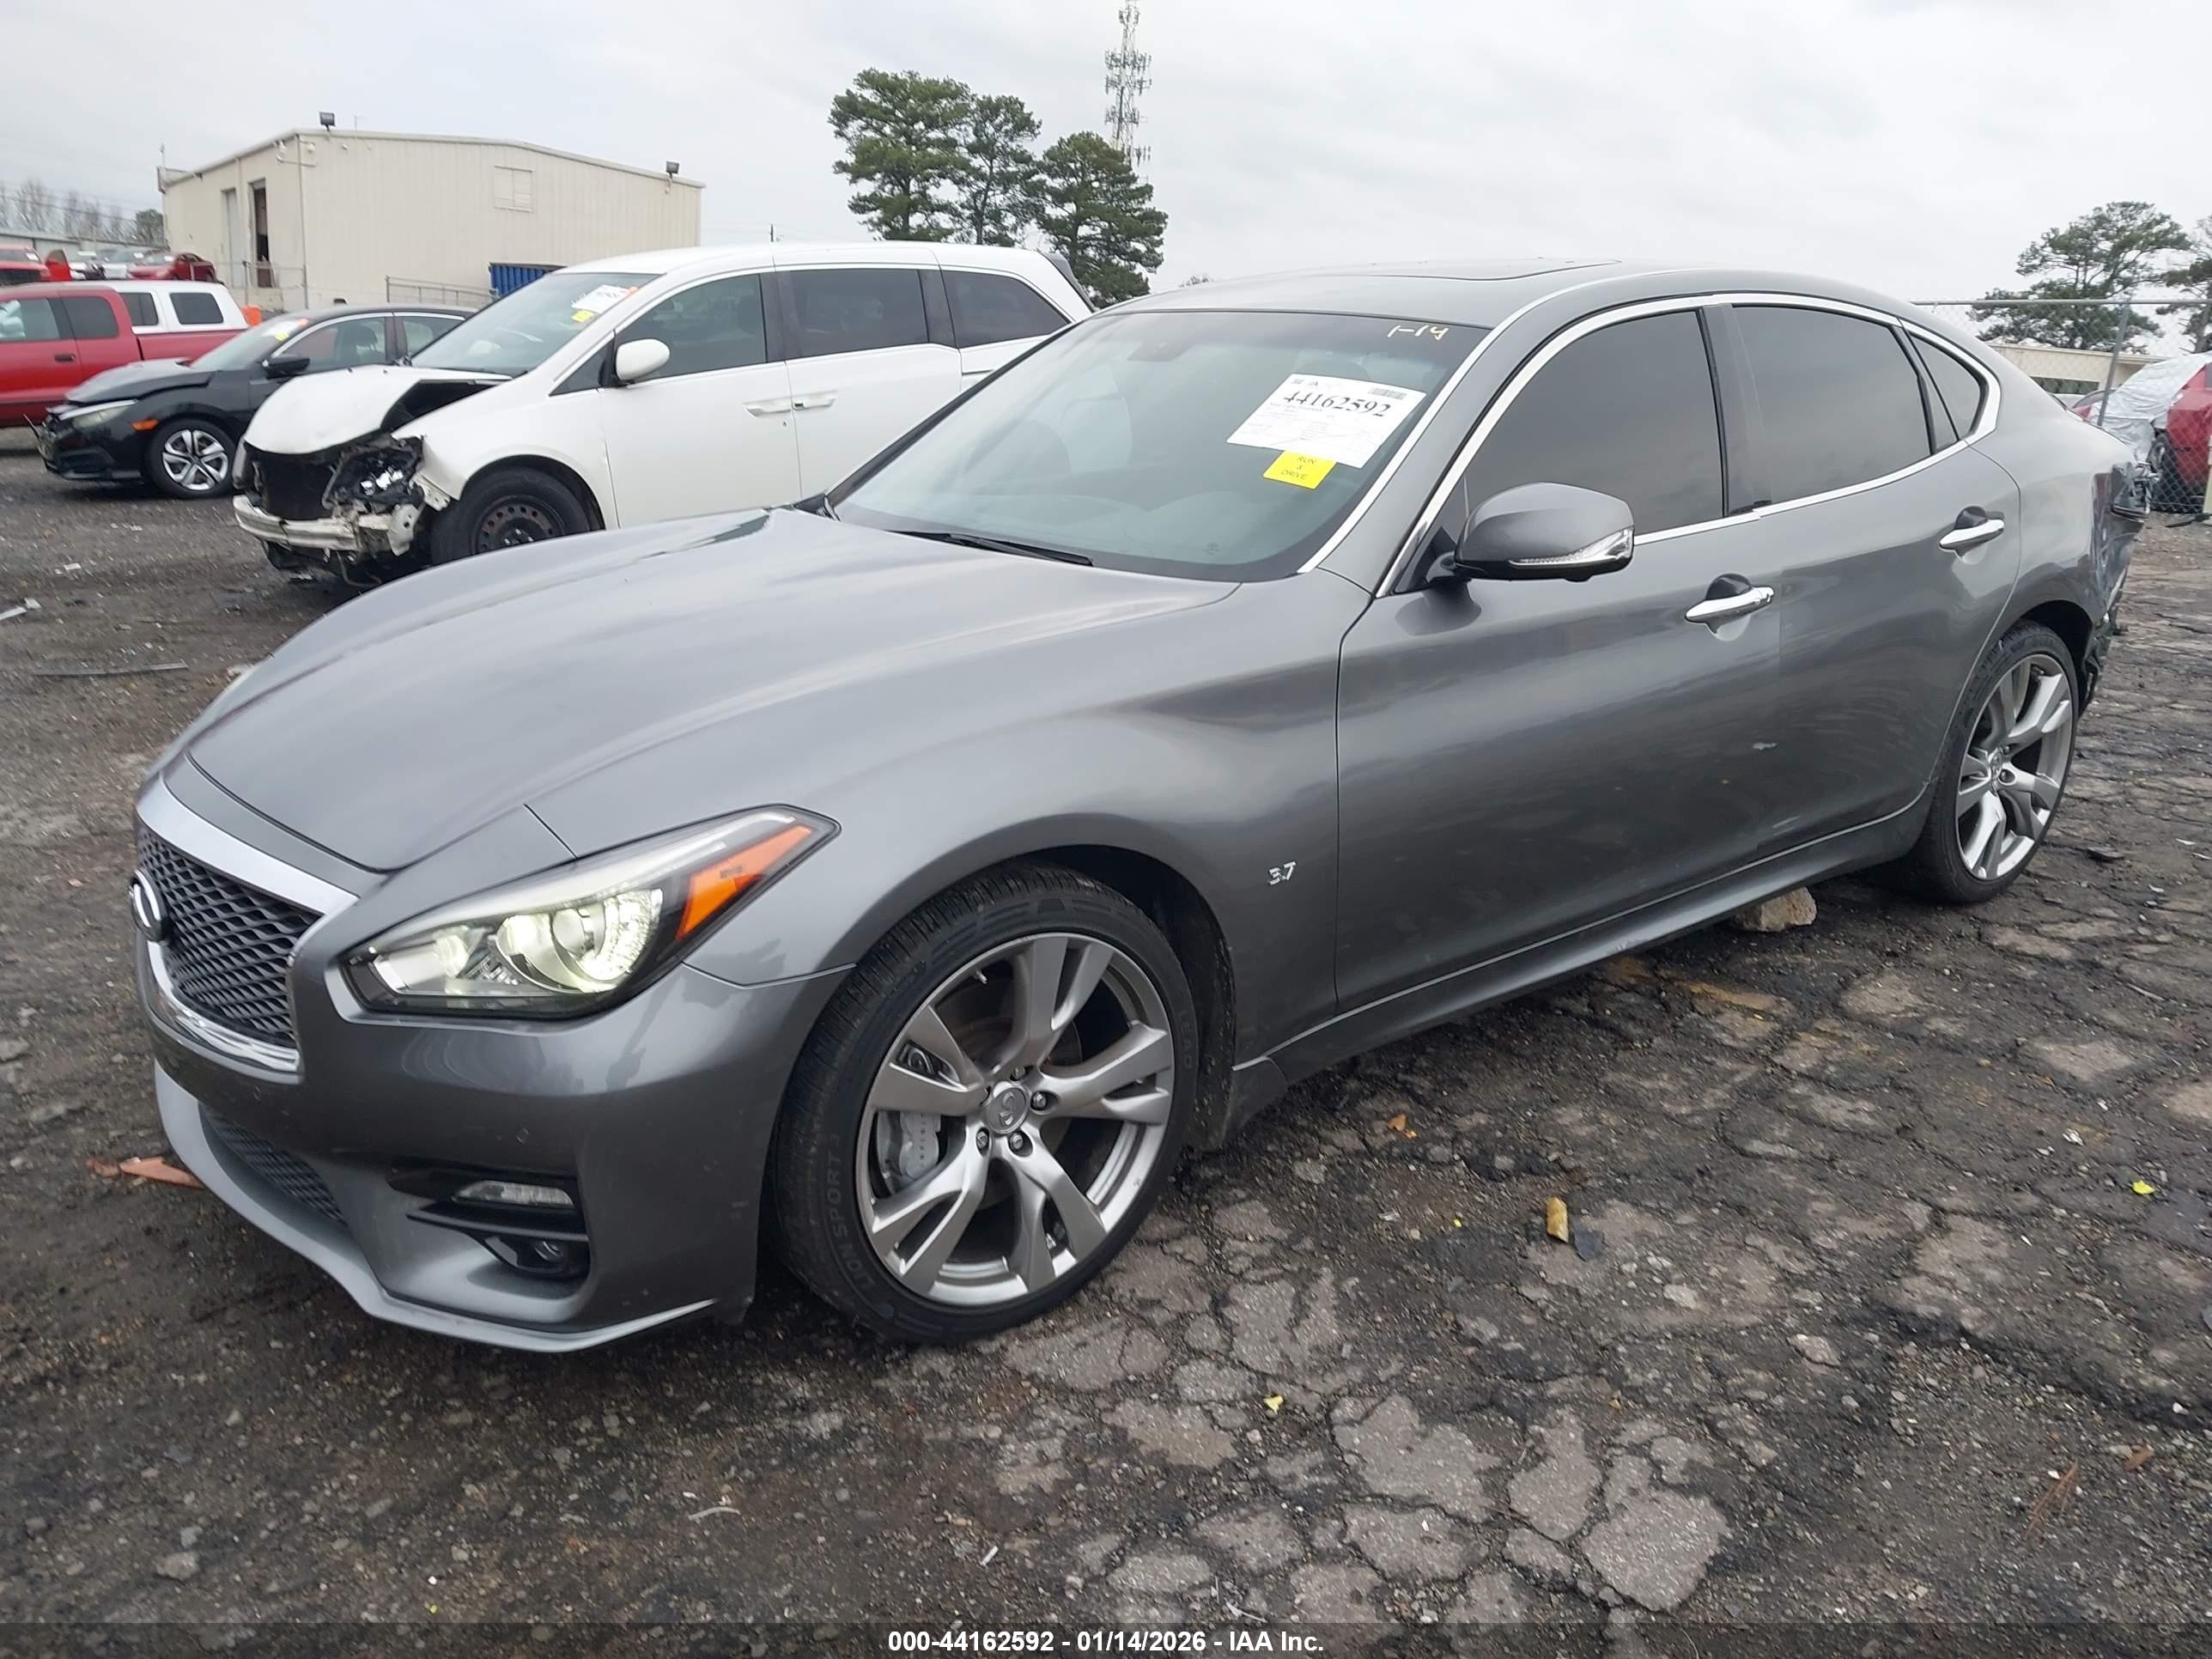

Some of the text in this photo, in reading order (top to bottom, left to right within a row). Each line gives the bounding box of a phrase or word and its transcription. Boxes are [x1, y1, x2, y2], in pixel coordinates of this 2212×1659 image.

[1284, 390, 1391, 417] 44162592
[1269, 860, 1297, 885] 3.7
[827, 1149, 848, 1238] SPORT
